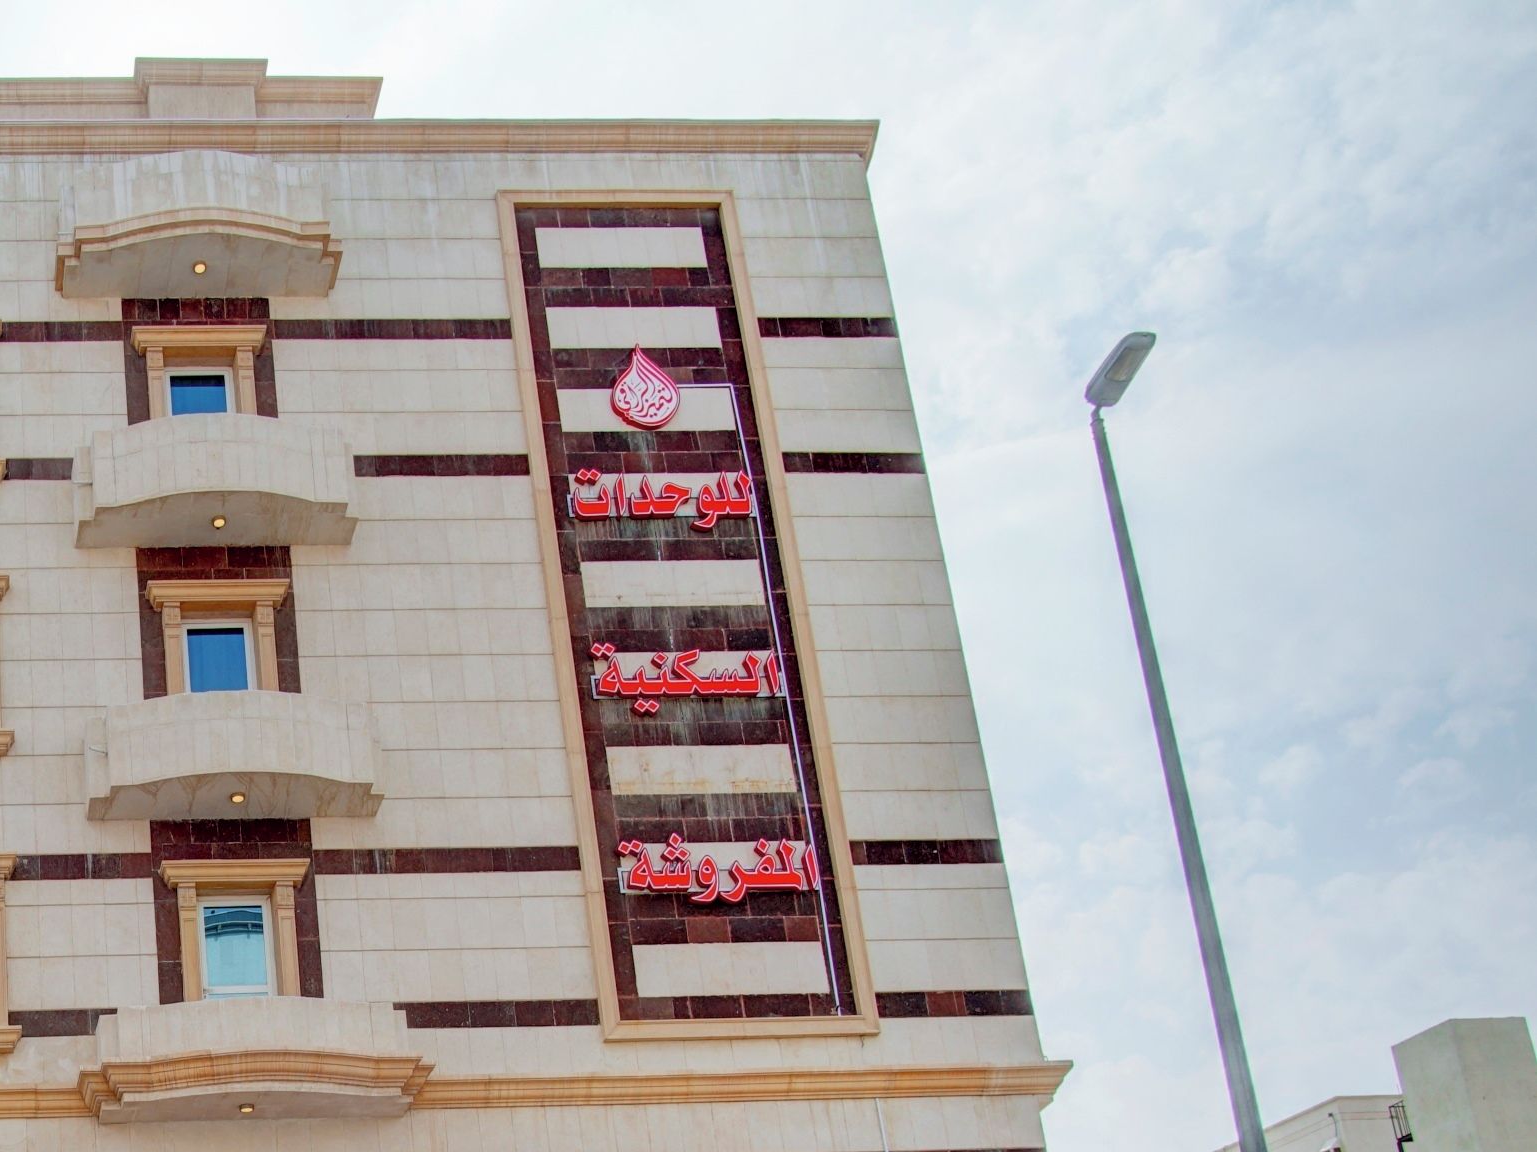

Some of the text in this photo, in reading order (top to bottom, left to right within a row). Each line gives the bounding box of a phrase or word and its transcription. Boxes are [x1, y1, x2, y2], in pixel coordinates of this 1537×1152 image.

[573, 467, 754, 532] للوحدات
[590, 641, 782, 716] السكنية
[616, 831, 820, 905] المفروشة
